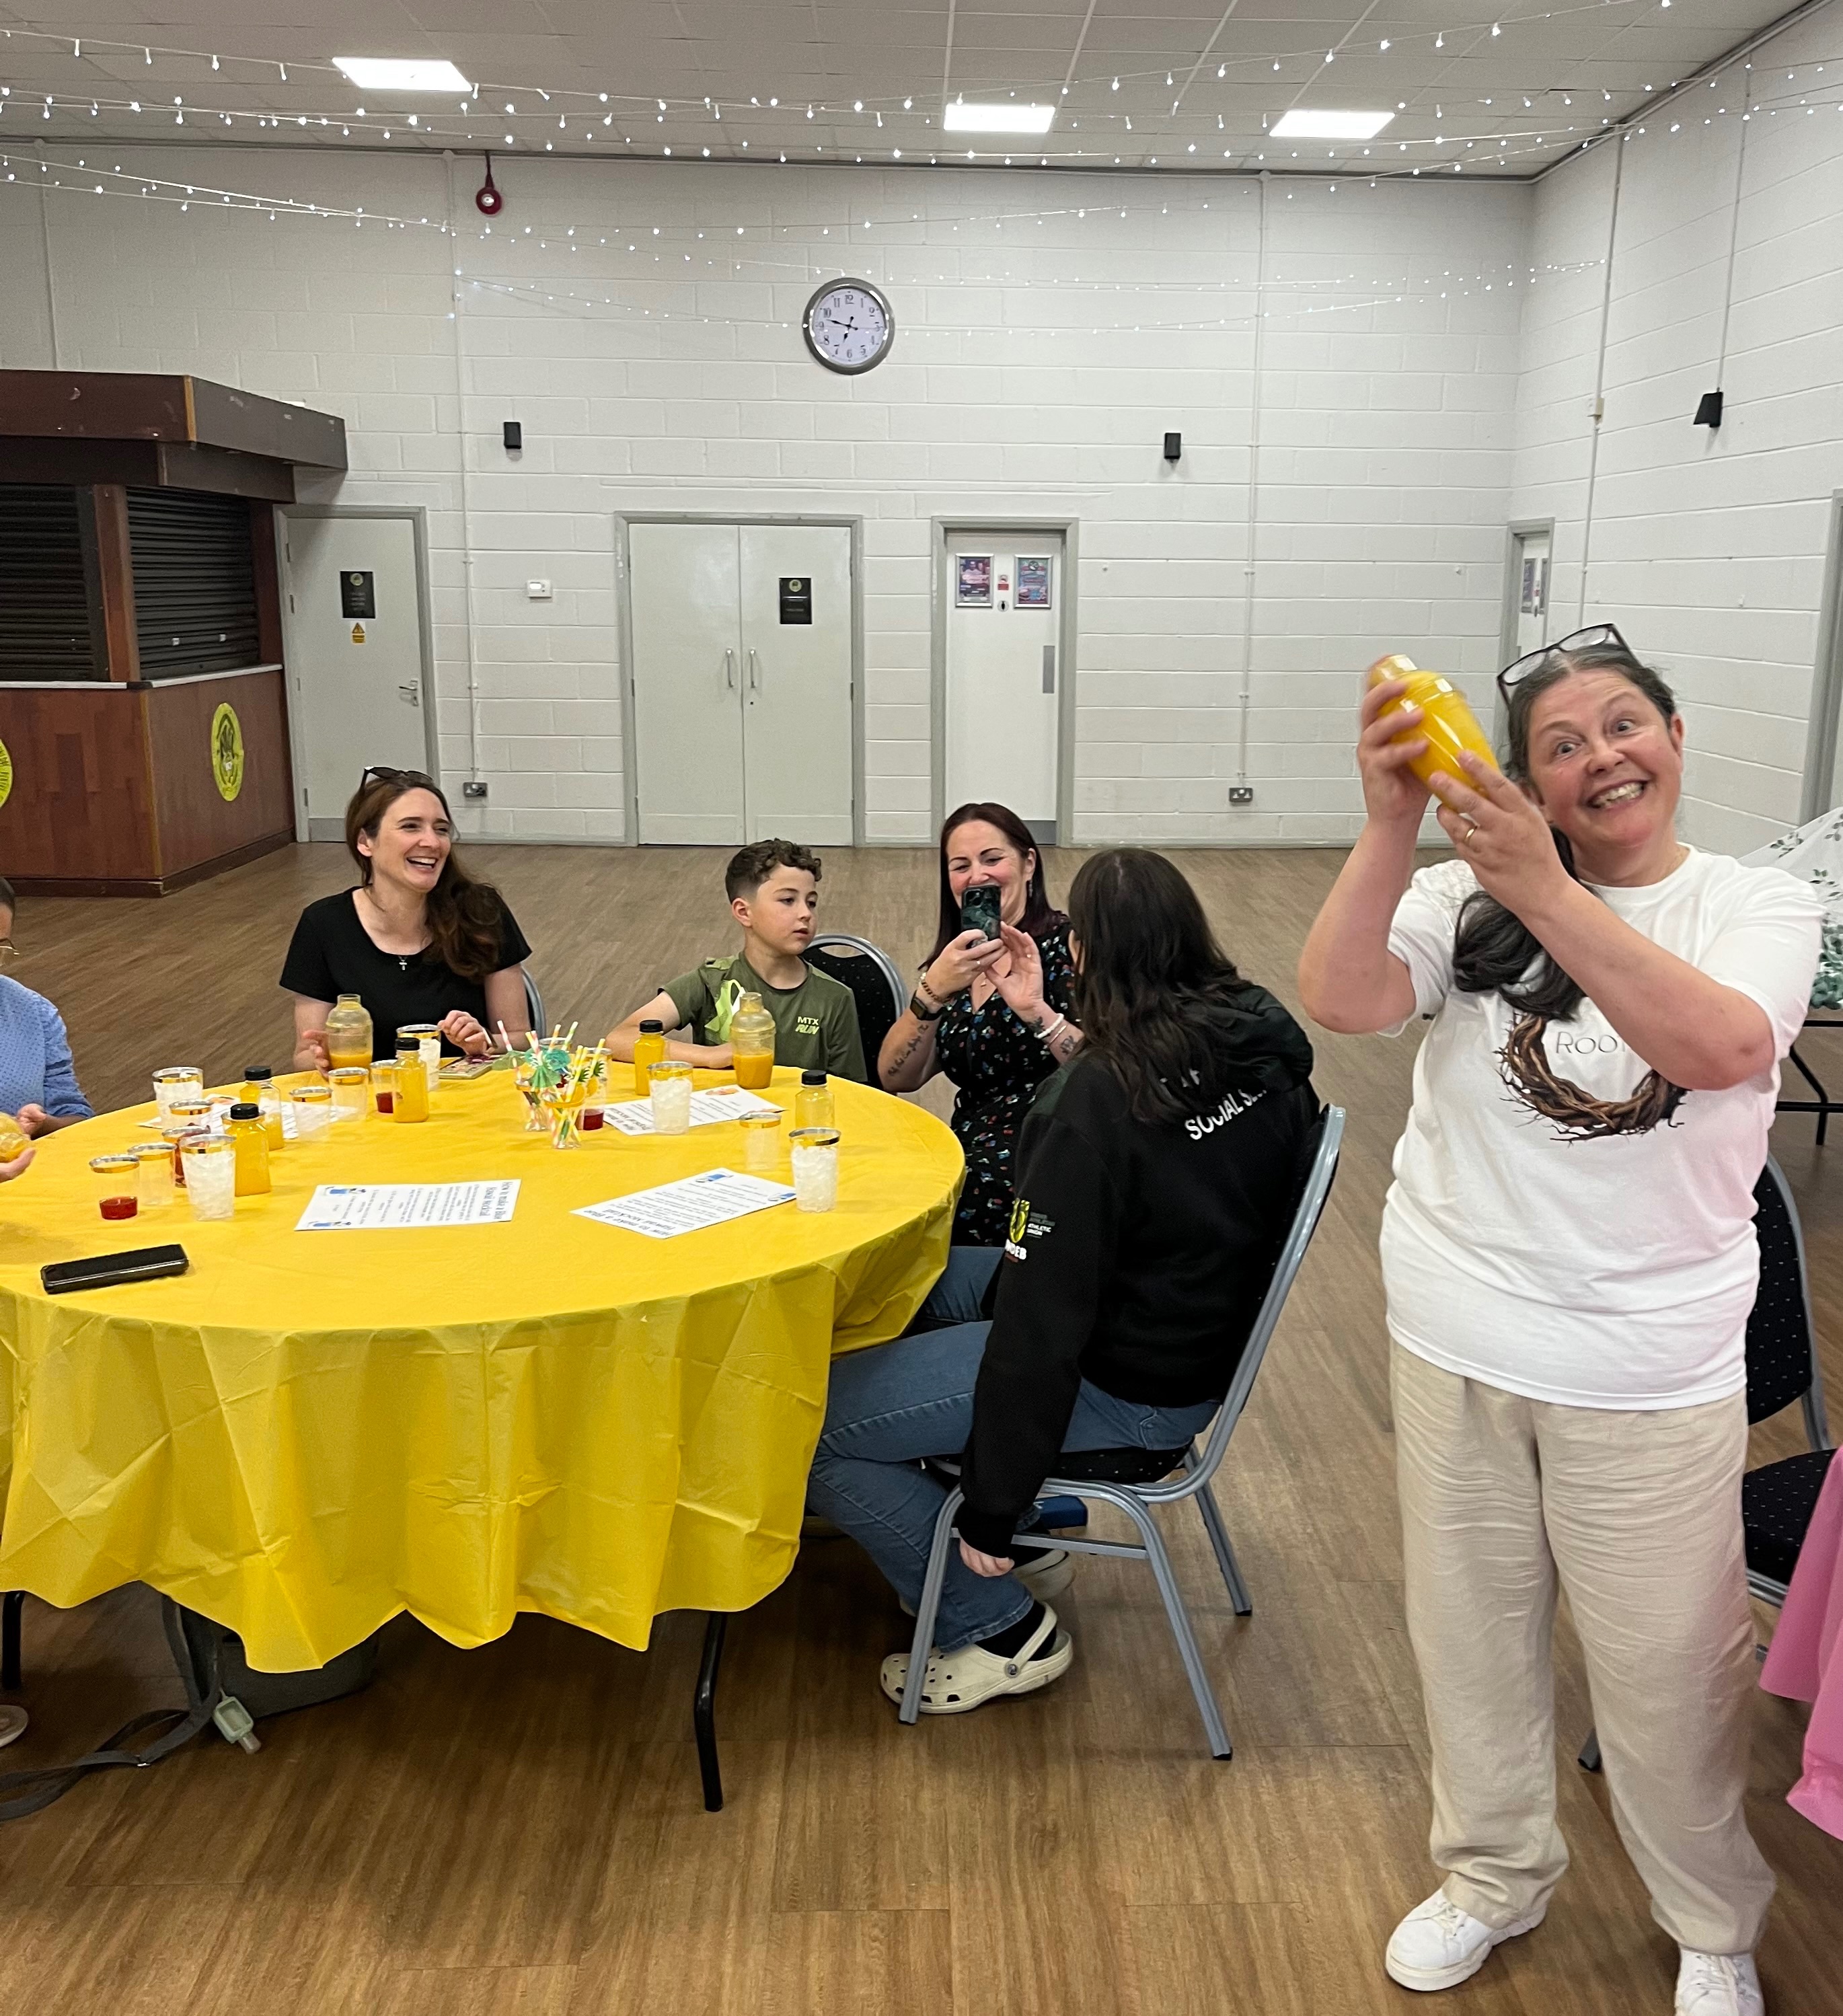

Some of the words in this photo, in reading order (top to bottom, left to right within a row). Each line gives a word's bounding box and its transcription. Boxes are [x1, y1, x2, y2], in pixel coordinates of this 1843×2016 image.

[833, 297, 840, 308] 11
[844, 294, 854, 305] 12
[860, 297, 864, 309] 1
[823, 307, 832, 318] 10
[868, 307, 875, 318] 2
[823, 334, 830, 346] 8
[833, 344, 840, 355] 7
[846, 348, 853, 359] 6
[797, 1016, 819, 1025] MTX
[795, 1024, 820, 1035] RUN
[1556, 1031, 1626, 1055] ROO
